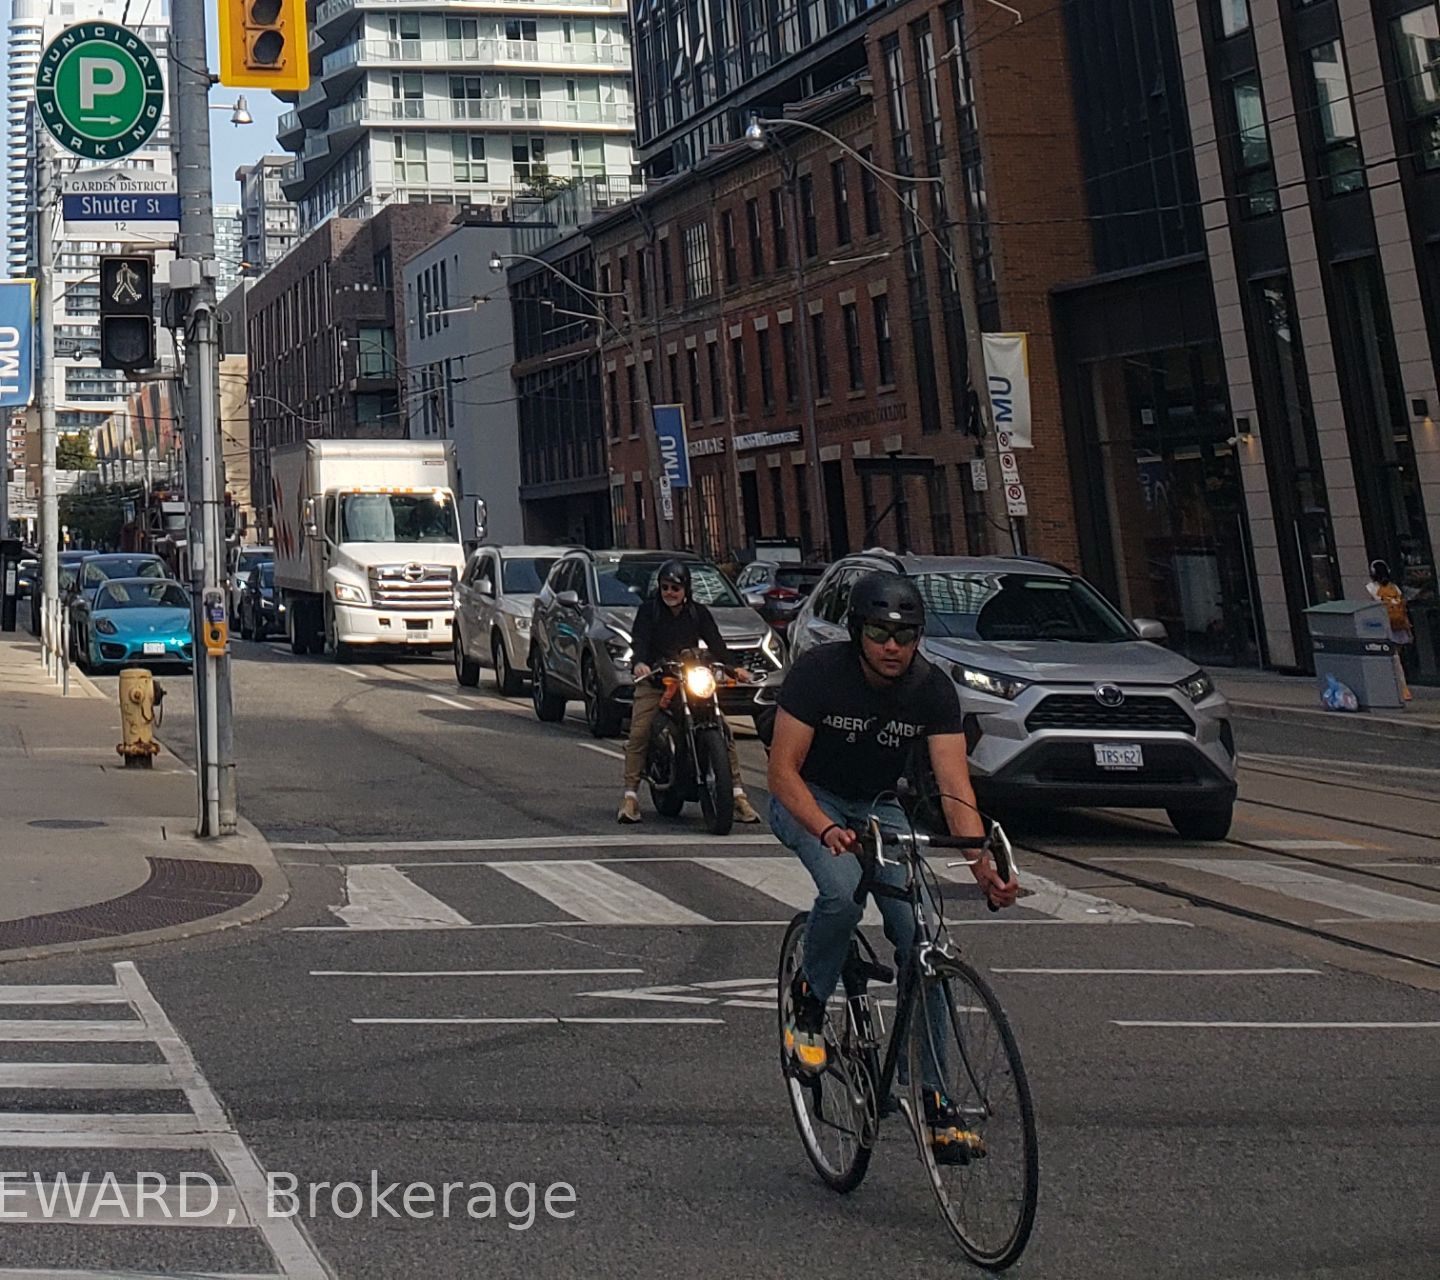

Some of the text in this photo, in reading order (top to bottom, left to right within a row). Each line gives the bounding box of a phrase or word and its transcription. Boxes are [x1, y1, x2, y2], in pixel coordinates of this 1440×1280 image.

[42, 27, 156, 87] MUNICIPAL
[80, 56, 126, 110] P
[43, 101, 158, 155] PARKING
[71, 180, 168, 192] GARDEN DISTRICT
[81, 195, 160, 215] Shuter St
[114, 221, 127, 232] 12
[845, 732, 857, 743] &
